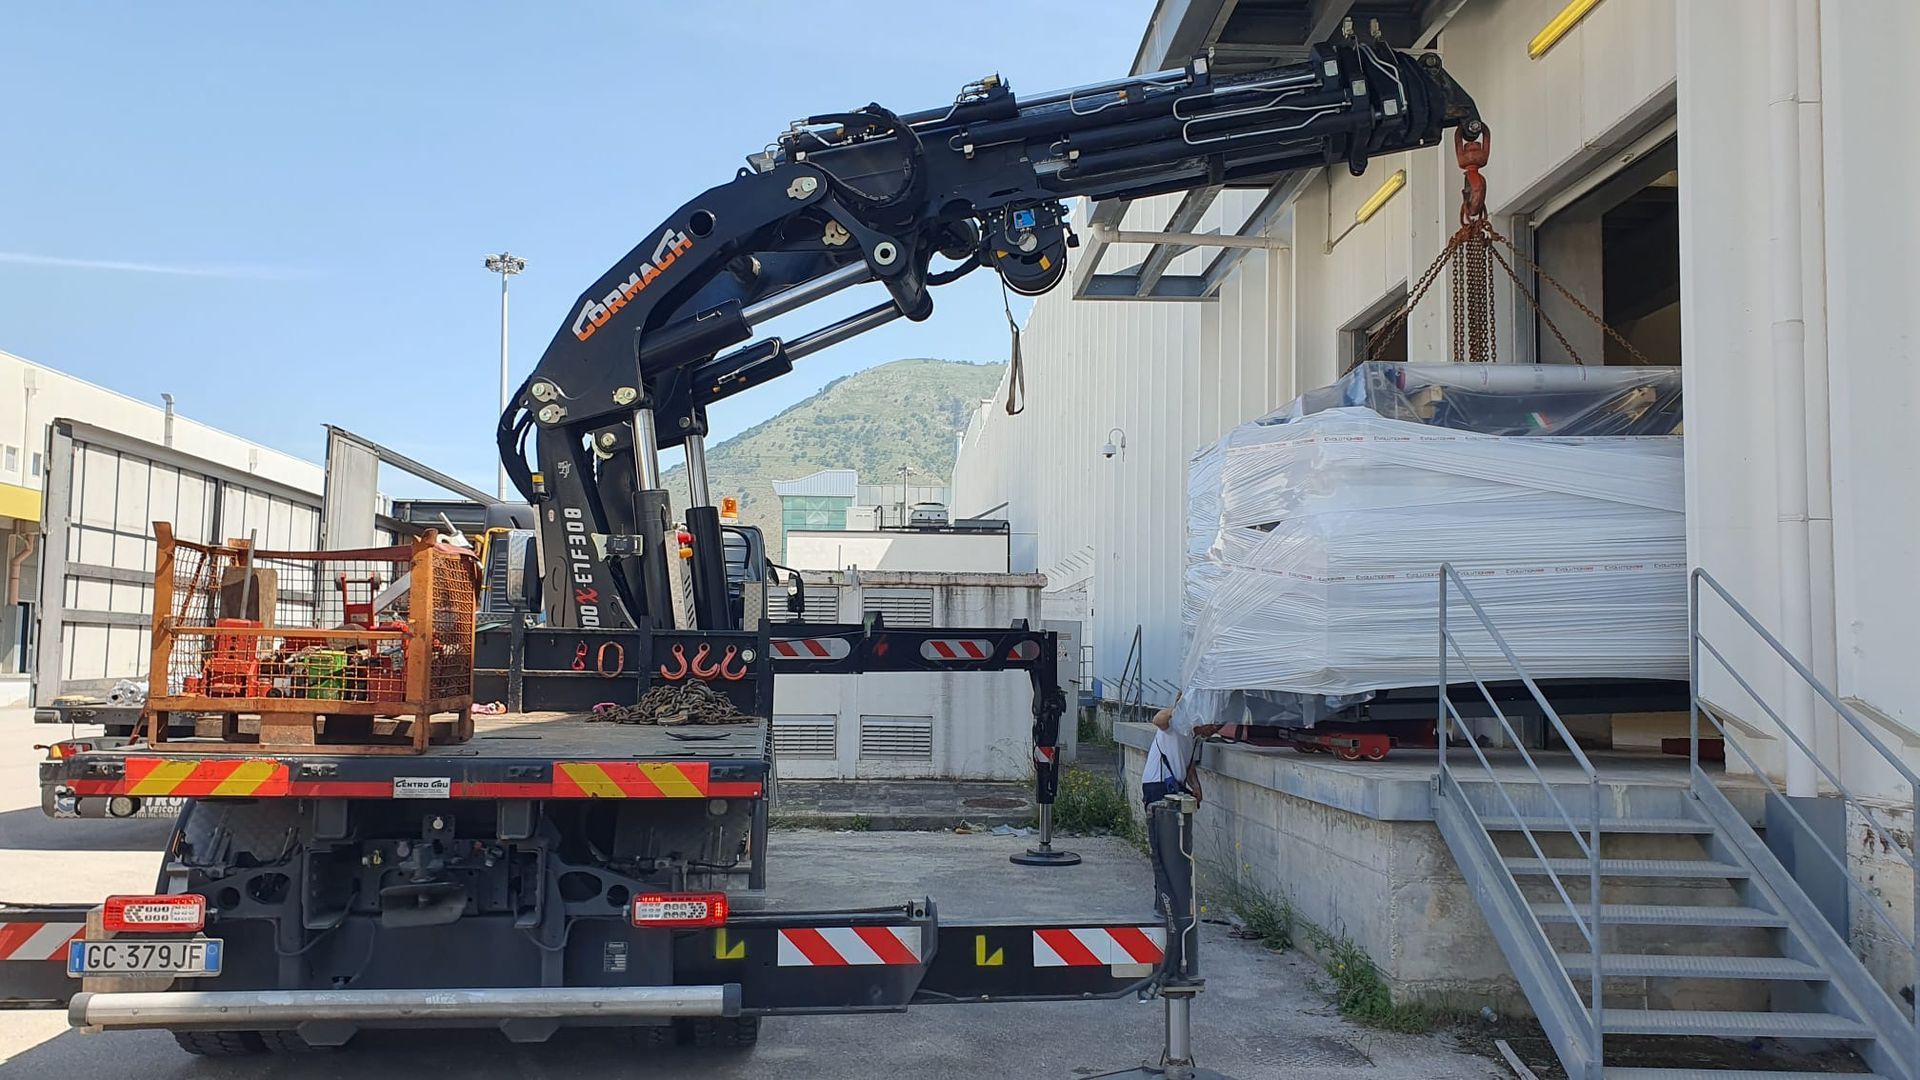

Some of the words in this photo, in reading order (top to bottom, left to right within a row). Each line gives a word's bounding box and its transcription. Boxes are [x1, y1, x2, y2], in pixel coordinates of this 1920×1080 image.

[571, 228, 693, 342] CORMACH
[395, 779, 429, 788] CENTRO
[431, 779, 449, 788] GRU
